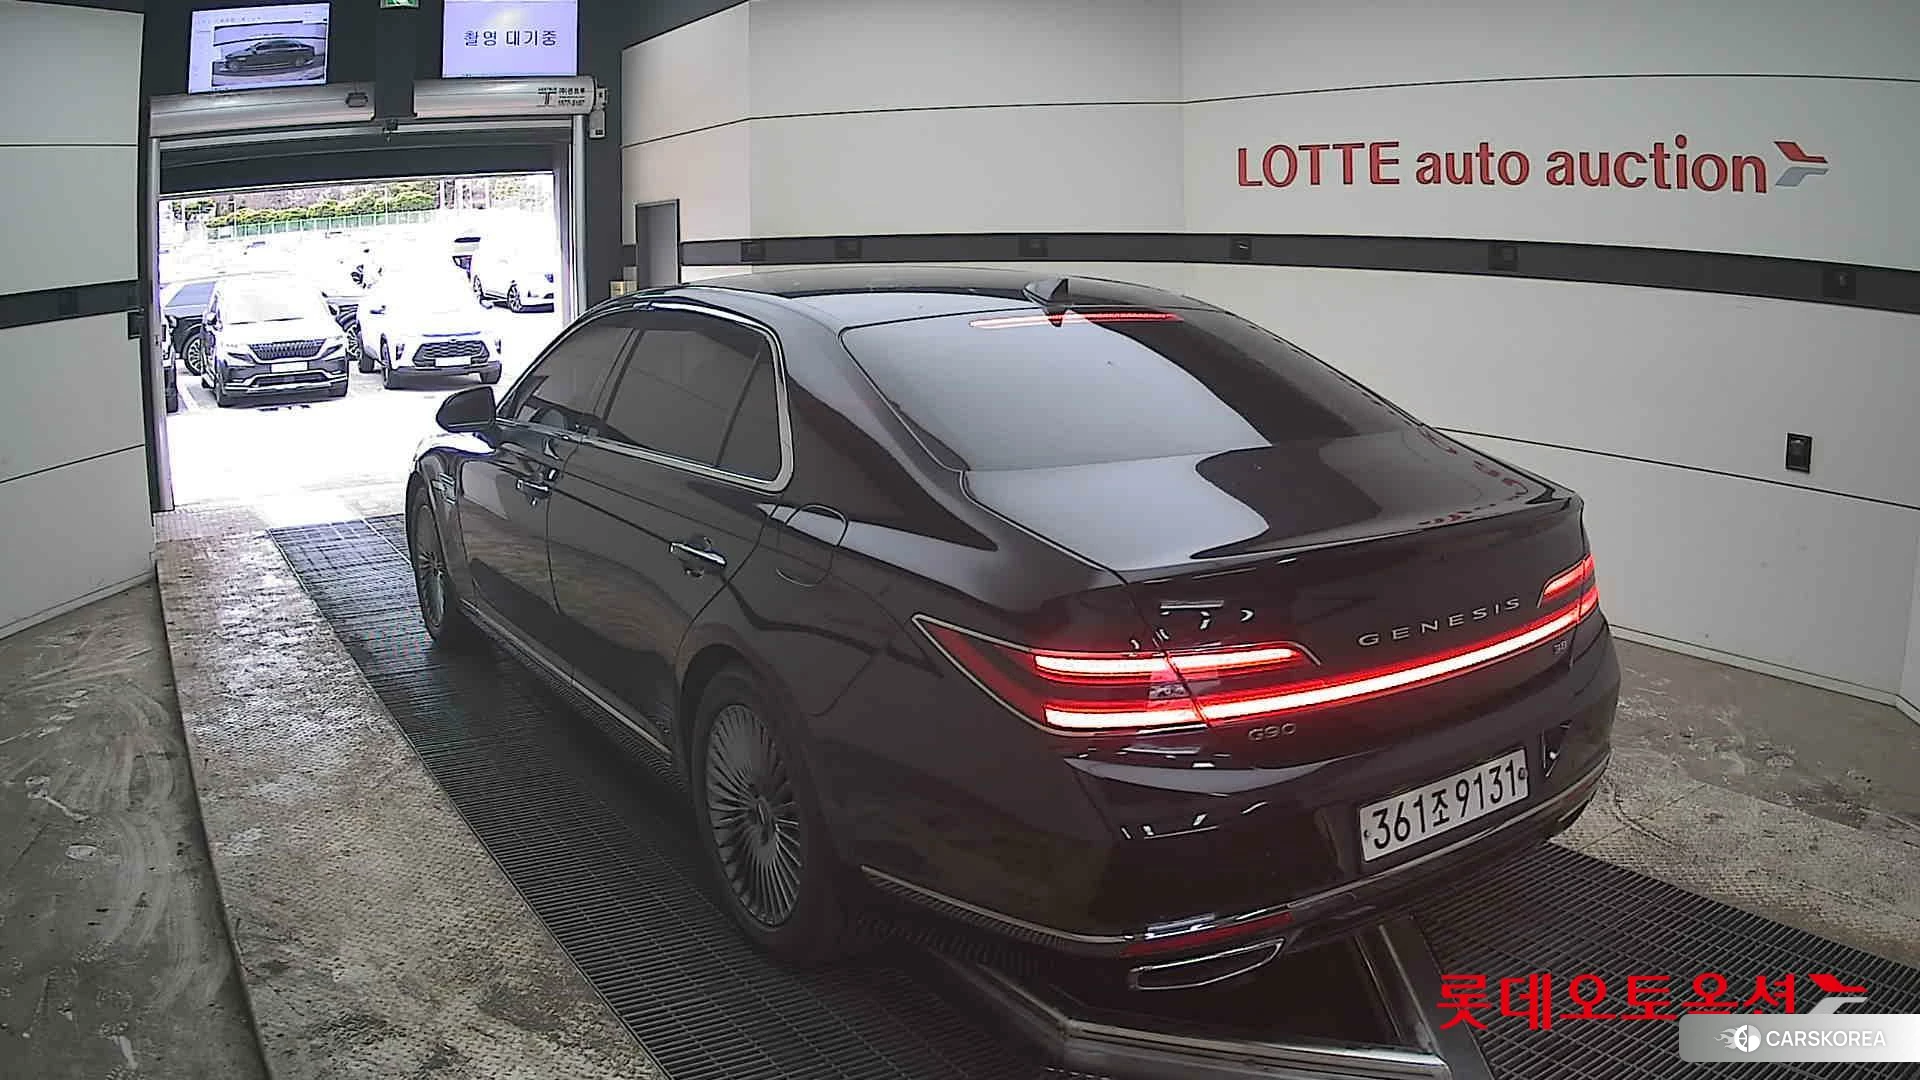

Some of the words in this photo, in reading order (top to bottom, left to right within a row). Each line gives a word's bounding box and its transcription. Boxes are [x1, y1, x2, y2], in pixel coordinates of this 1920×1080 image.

[506, 30, 557, 46] 대기중
[1237, 141, 1400, 187] LOTTE
[1415, 141, 1529, 186] auto
[1545, 134, 1767, 193] auction
[1358, 598, 1520, 647] GENESIS
[1248, 722, 1296, 741] G90
[1372, 759, 1516, 849] 361조9131
